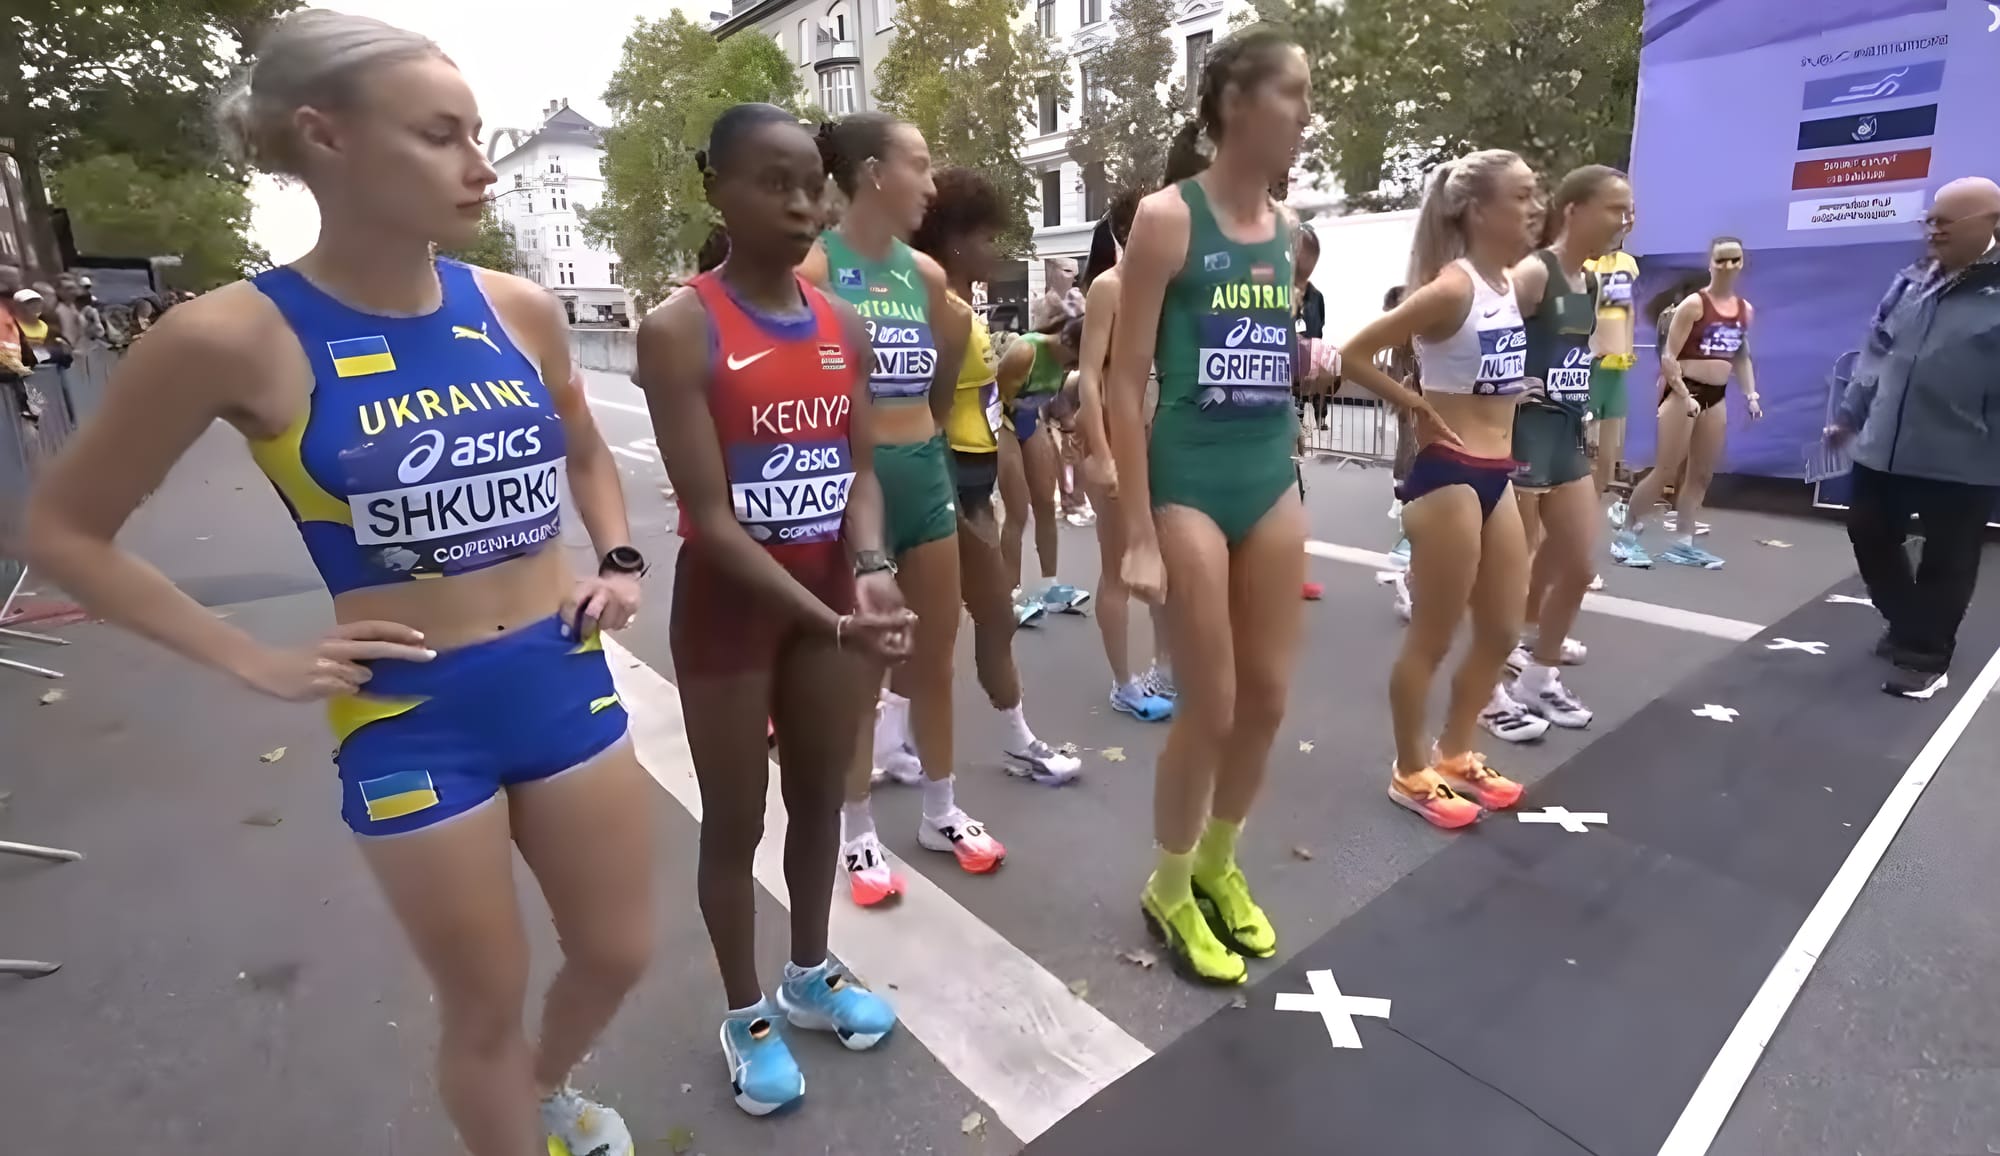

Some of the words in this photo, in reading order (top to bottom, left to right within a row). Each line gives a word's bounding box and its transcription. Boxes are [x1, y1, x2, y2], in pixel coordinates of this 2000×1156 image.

[358, 380, 540, 435] UKRAINE
[450, 424, 542, 467] asics
[367, 466, 558, 538] SHKURKO
